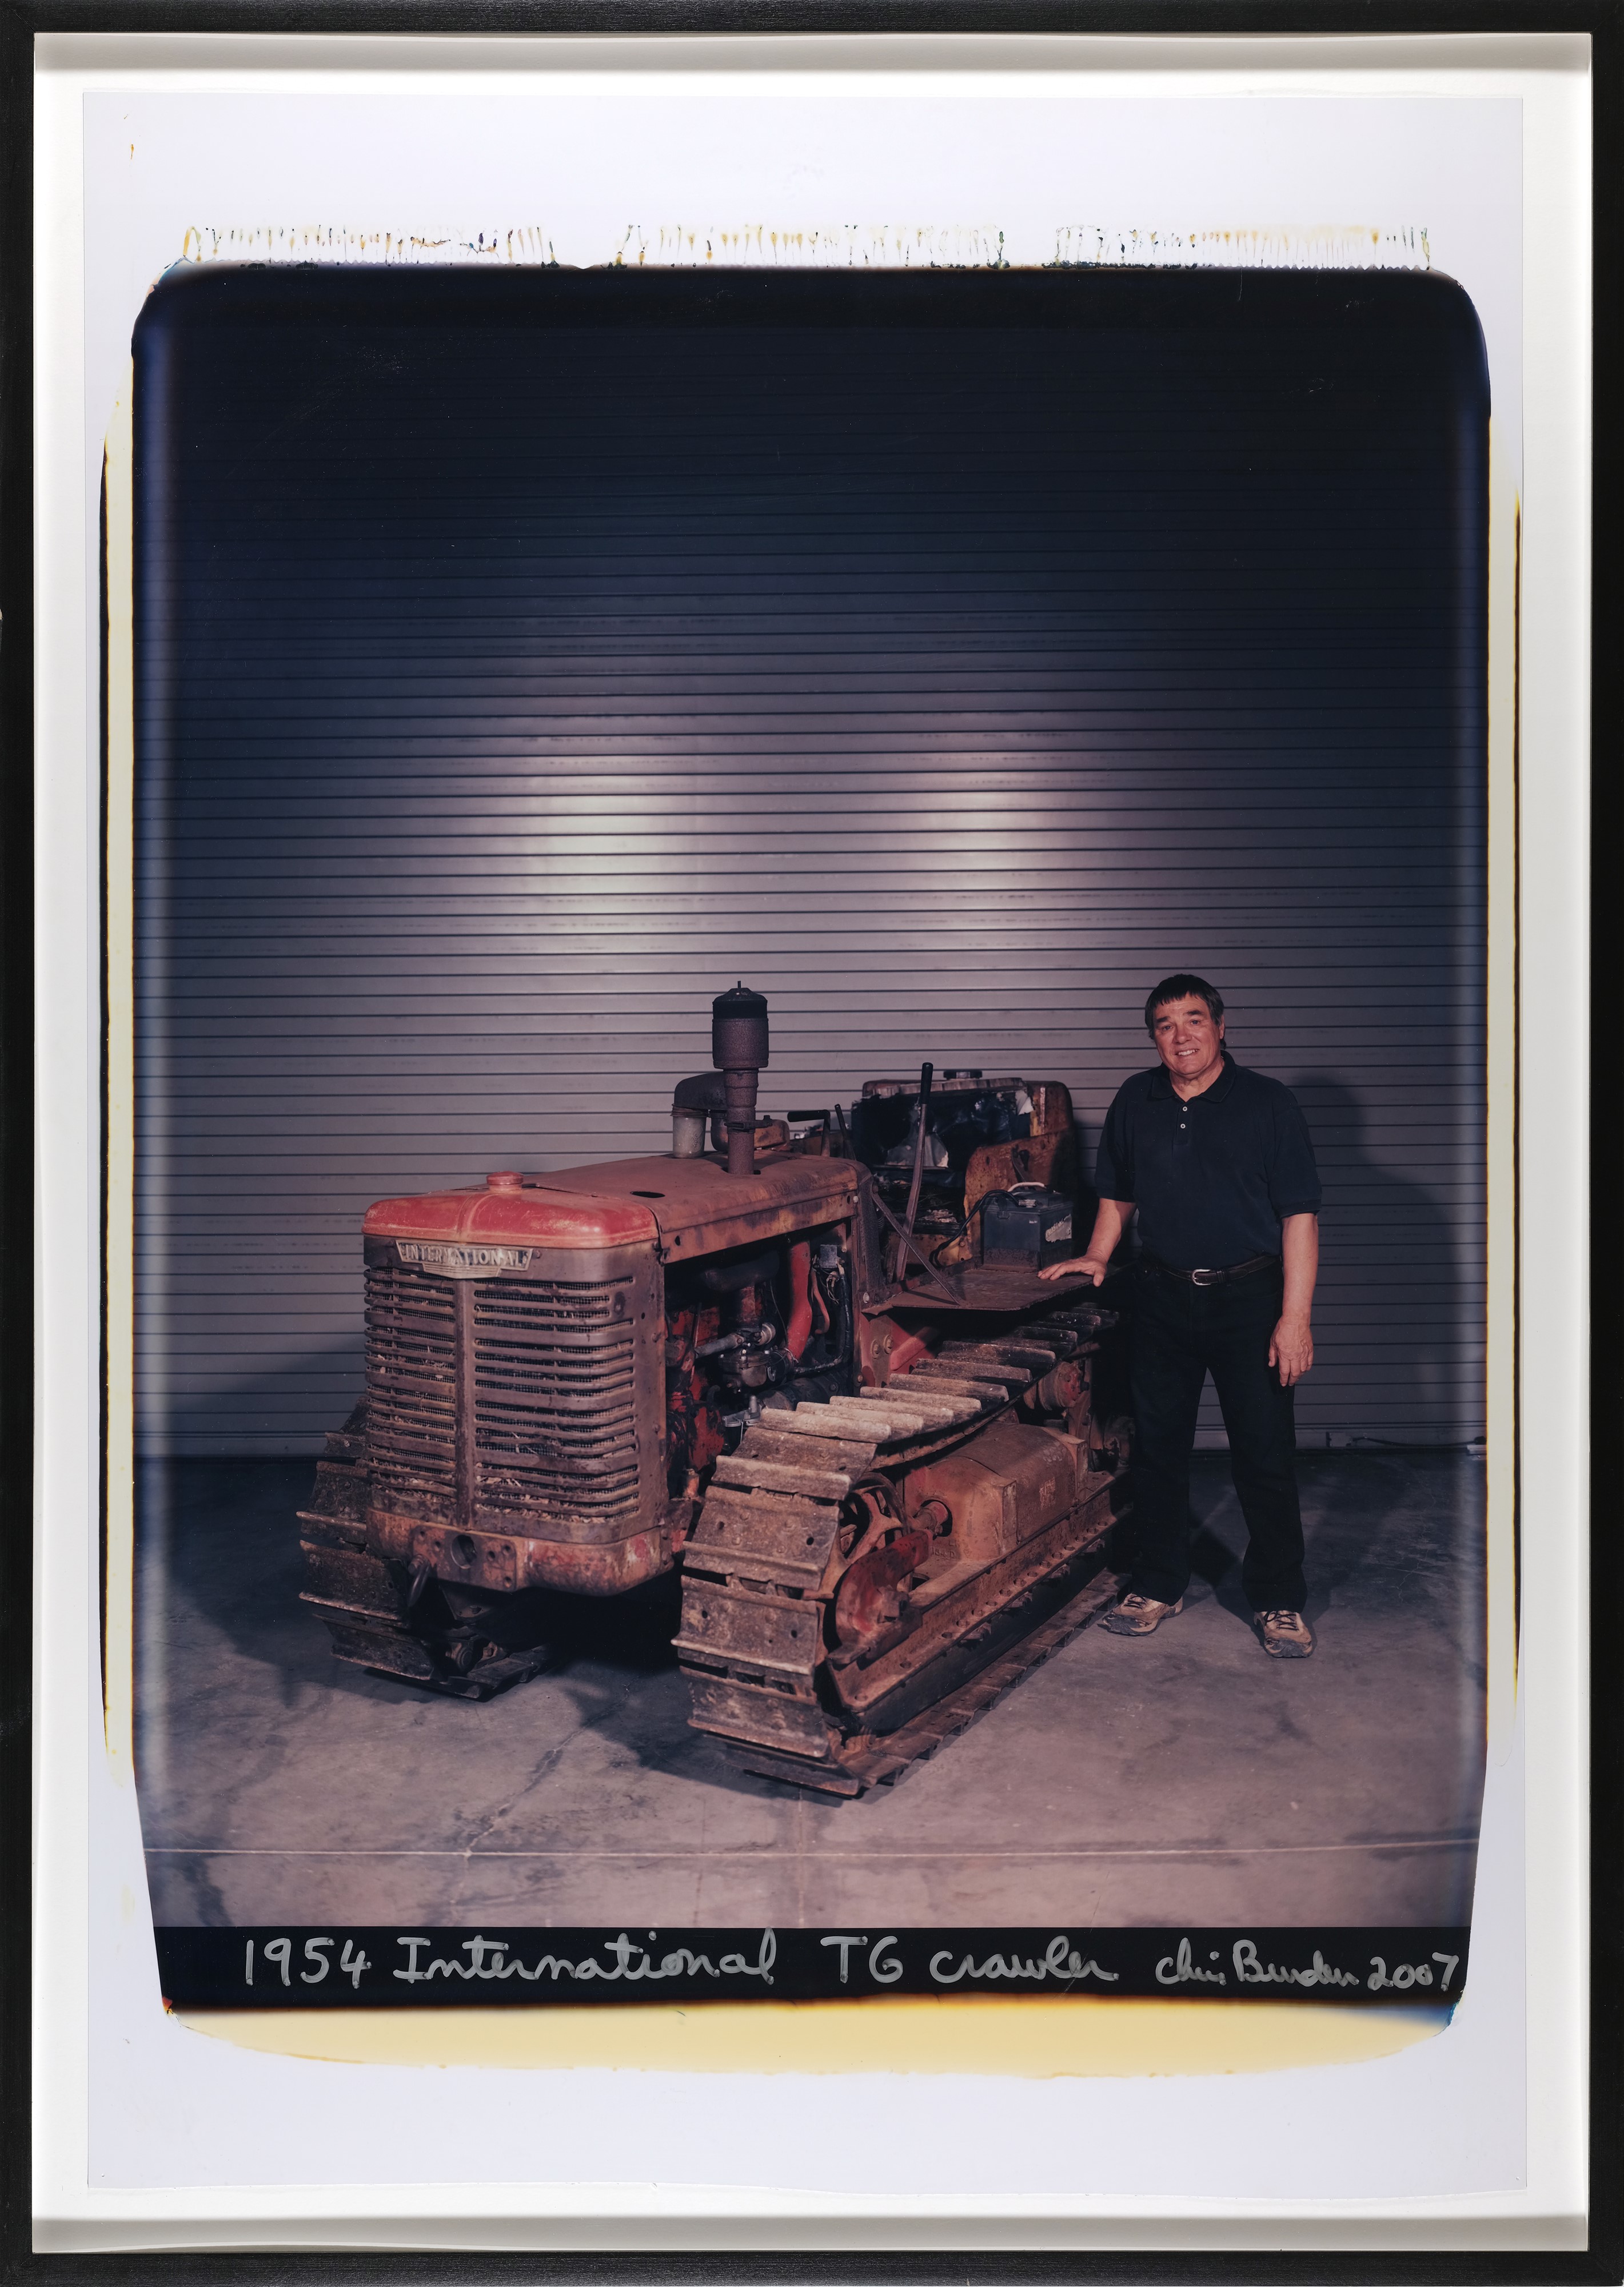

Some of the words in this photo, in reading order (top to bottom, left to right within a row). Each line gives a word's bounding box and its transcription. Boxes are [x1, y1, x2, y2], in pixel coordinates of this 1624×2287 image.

[405, 1244, 522, 1266] INTERNATIONAL
[245, 1938, 372, 1989] 1954
[393, 1926, 777, 1985] International
[1367, 1952, 1459, 1992] 2007
